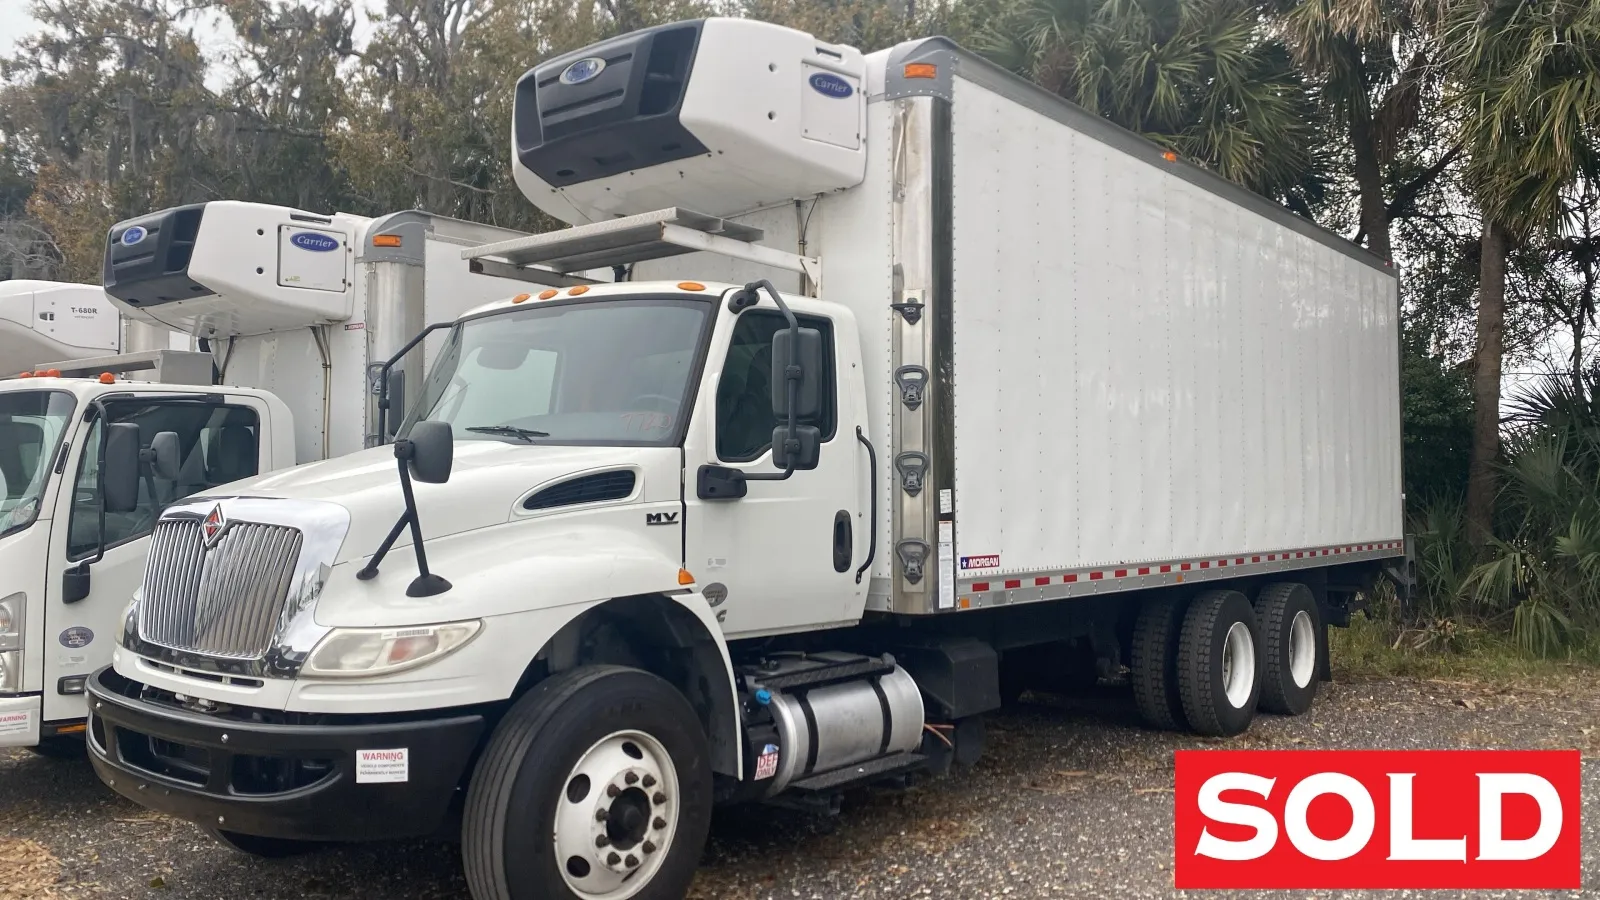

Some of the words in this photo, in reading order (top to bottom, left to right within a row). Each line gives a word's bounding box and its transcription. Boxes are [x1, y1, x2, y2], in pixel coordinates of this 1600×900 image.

[815, 77, 848, 93] Carrier
[297, 235, 333, 248] Carrier
[646, 511, 679, 523] MV
[968, 556, 999, 568] MORGAN
[363, 752, 403, 760] WARNING
[759, 753, 777, 768] DEF
